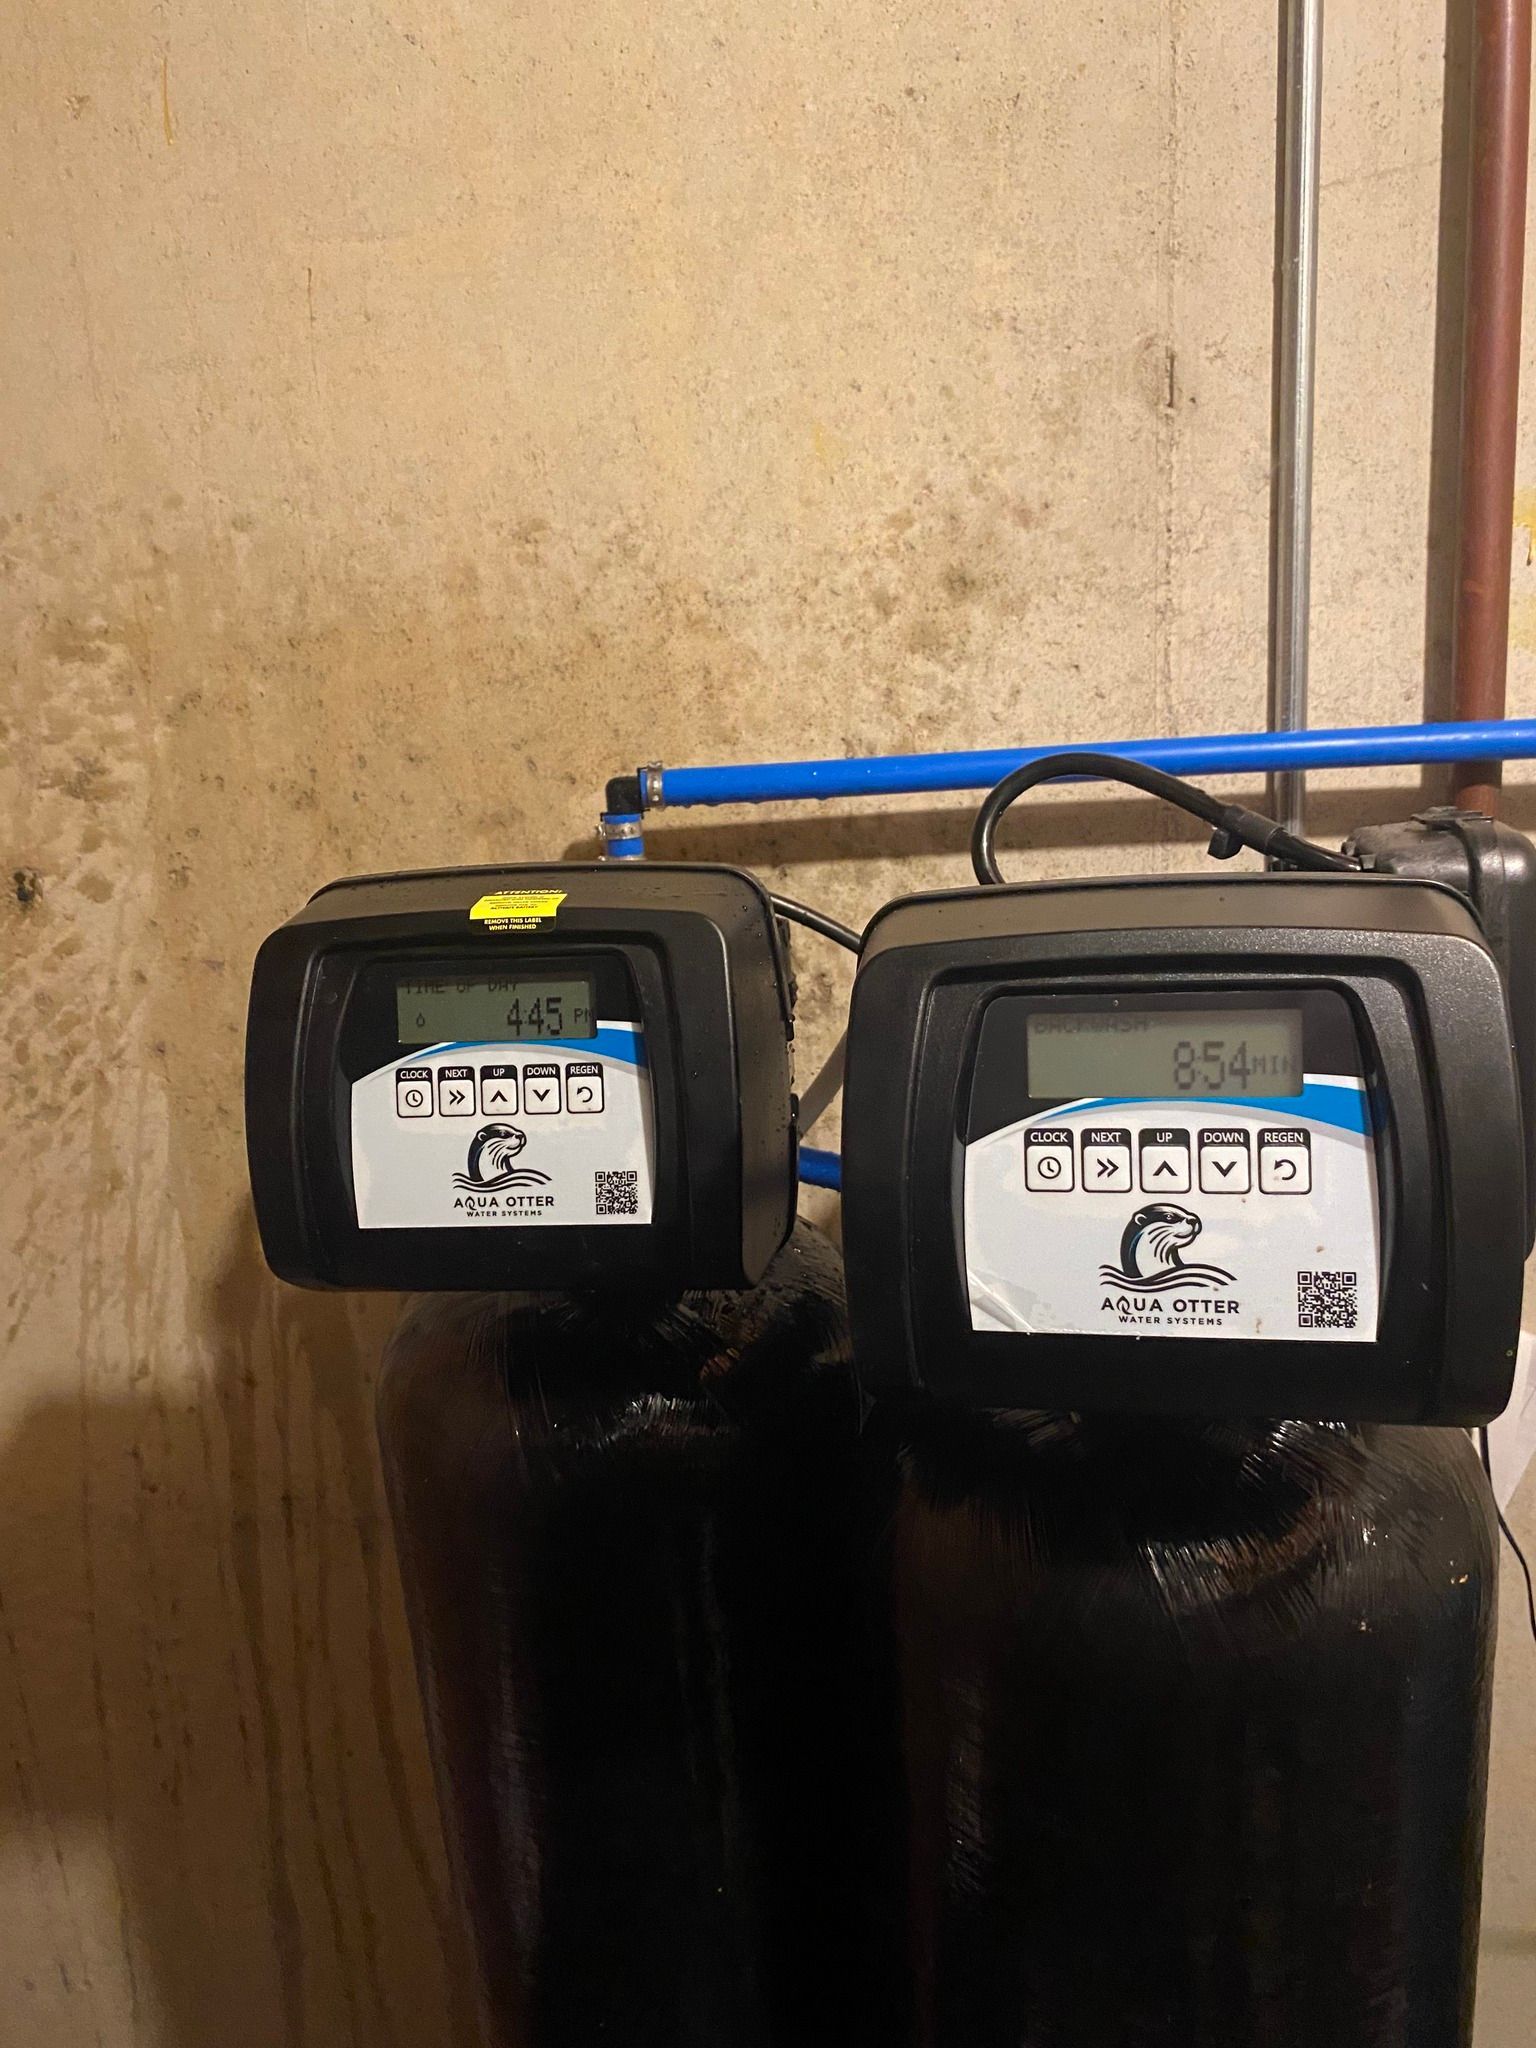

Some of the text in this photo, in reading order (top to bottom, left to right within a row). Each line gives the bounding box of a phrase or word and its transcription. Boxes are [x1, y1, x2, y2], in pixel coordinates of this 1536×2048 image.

[400, 1065, 599, 1079] CLOCK NEXT UP DOWN REGEN
[1174, 1041, 1251, 1090] 8:54
[1030, 1131, 1304, 1143] CLOCK NEXT UP DOWN REGEN
[453, 1195, 555, 1211] AQUA OTTER
[501, 1209, 543, 1217] SYSTEMS
[1100, 1295, 1240, 1315] AQUA OTTER
[1118, 1315, 1223, 1326] WATER SYSTEMS
